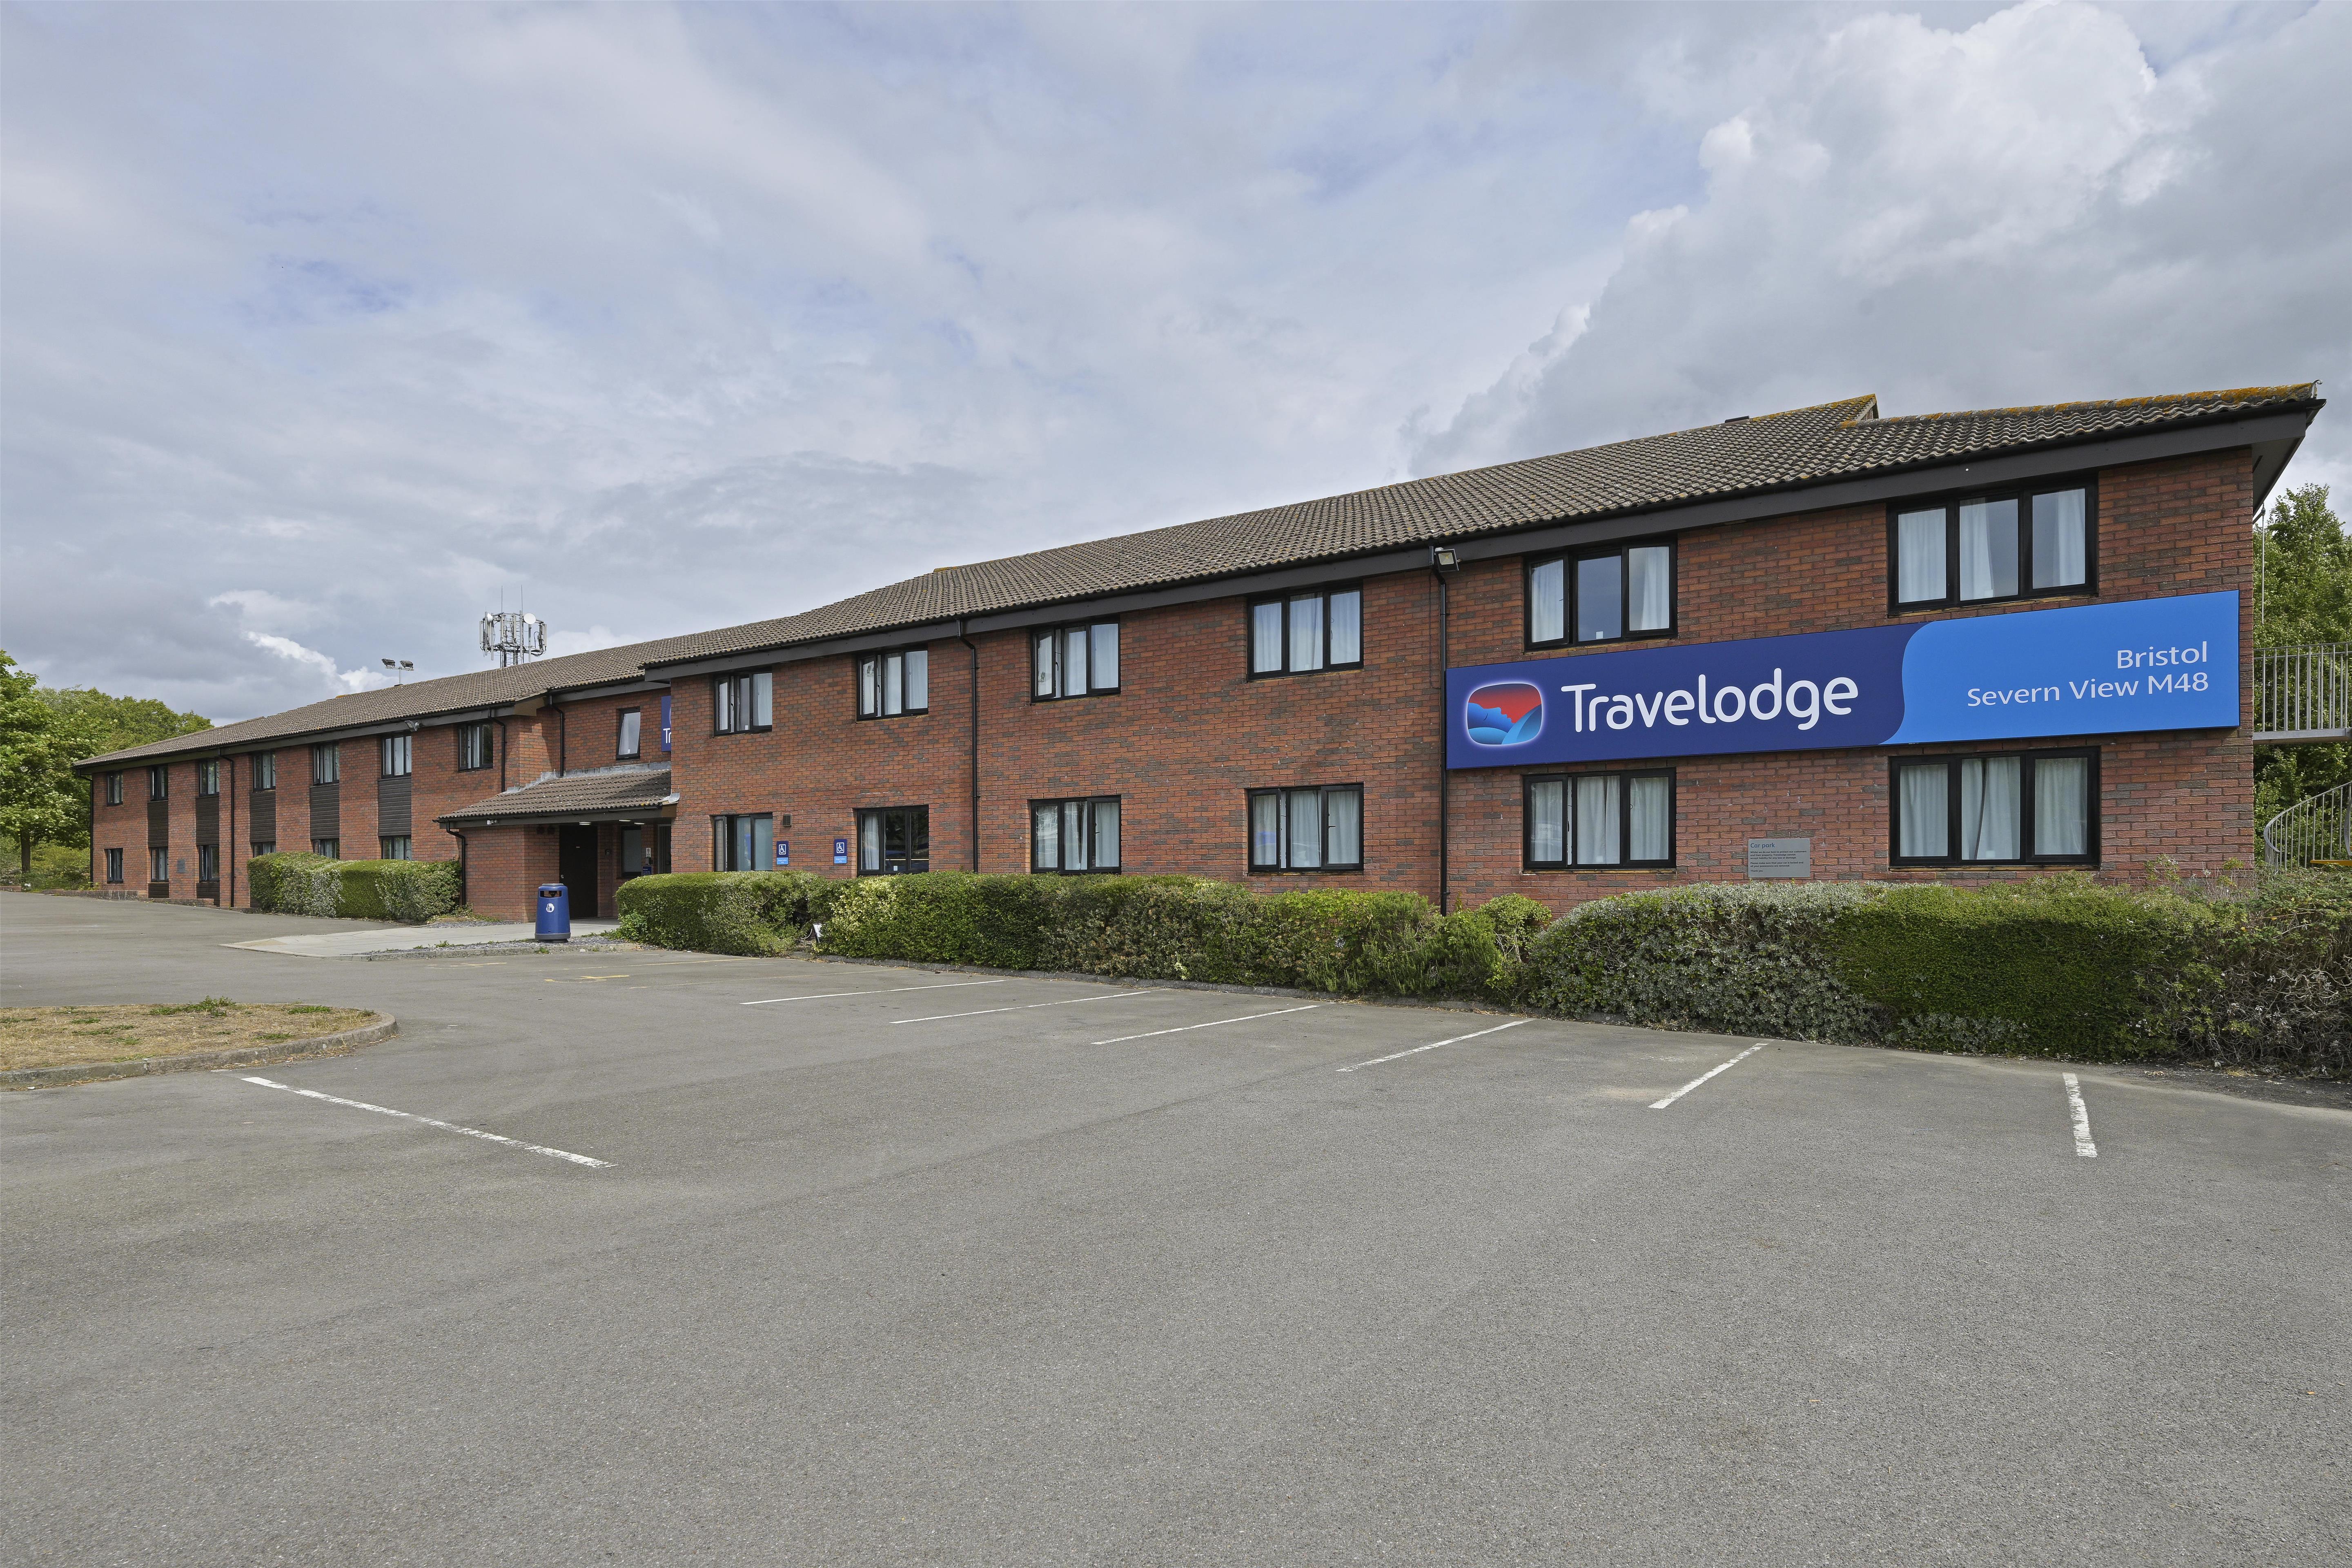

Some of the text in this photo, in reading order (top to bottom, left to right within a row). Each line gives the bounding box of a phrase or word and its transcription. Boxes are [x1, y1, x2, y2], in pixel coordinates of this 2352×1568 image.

[2118, 641, 2207, 668] Bristol
[1561, 668, 1859, 733] Travelodge
[1968, 672, 2208, 706] Severn View M48
